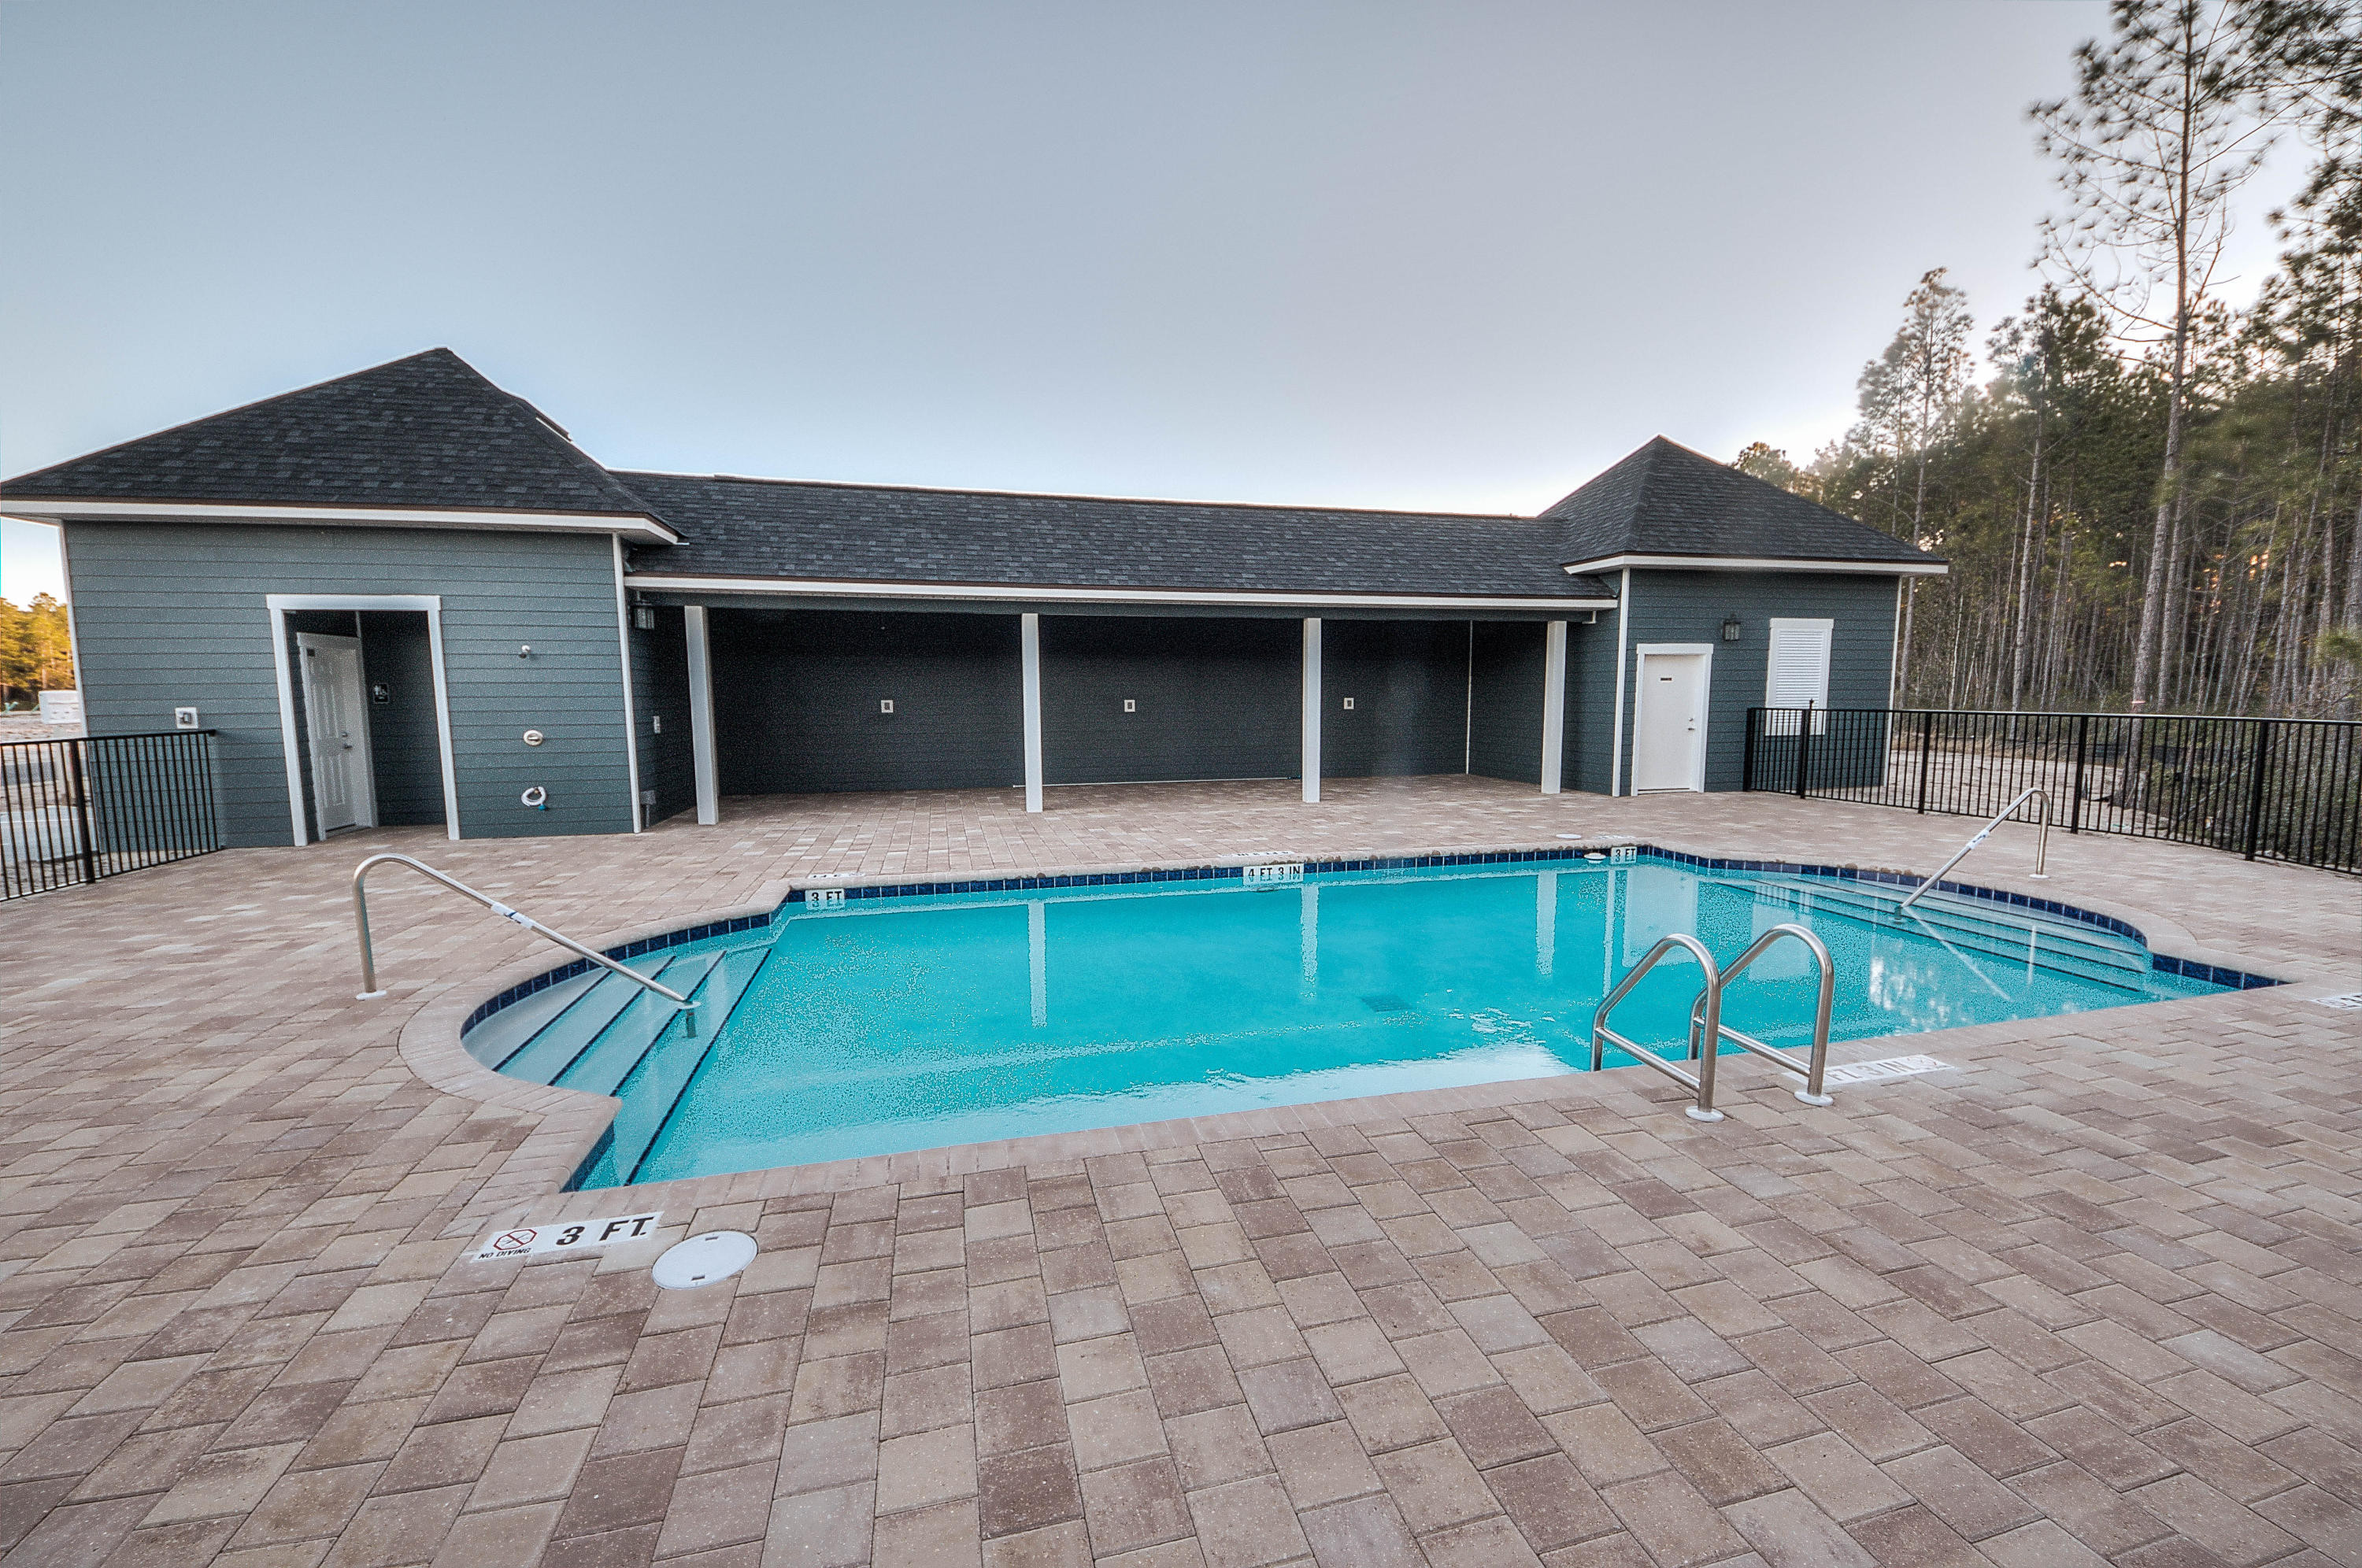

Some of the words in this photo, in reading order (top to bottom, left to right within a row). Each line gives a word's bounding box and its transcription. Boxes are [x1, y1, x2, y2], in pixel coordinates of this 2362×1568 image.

[1615, 849, 1621, 860] 3
[1278, 867, 1285, 878] 3
[1289, 866, 1301, 878] IN
[811, 892, 820, 904] 3
[1857, 1065, 1884, 1076] 3
[555, 1226, 586, 1246] 3
[598, 1216, 655, 1241] FT.
[496, 1248, 532, 1257] DIVING
